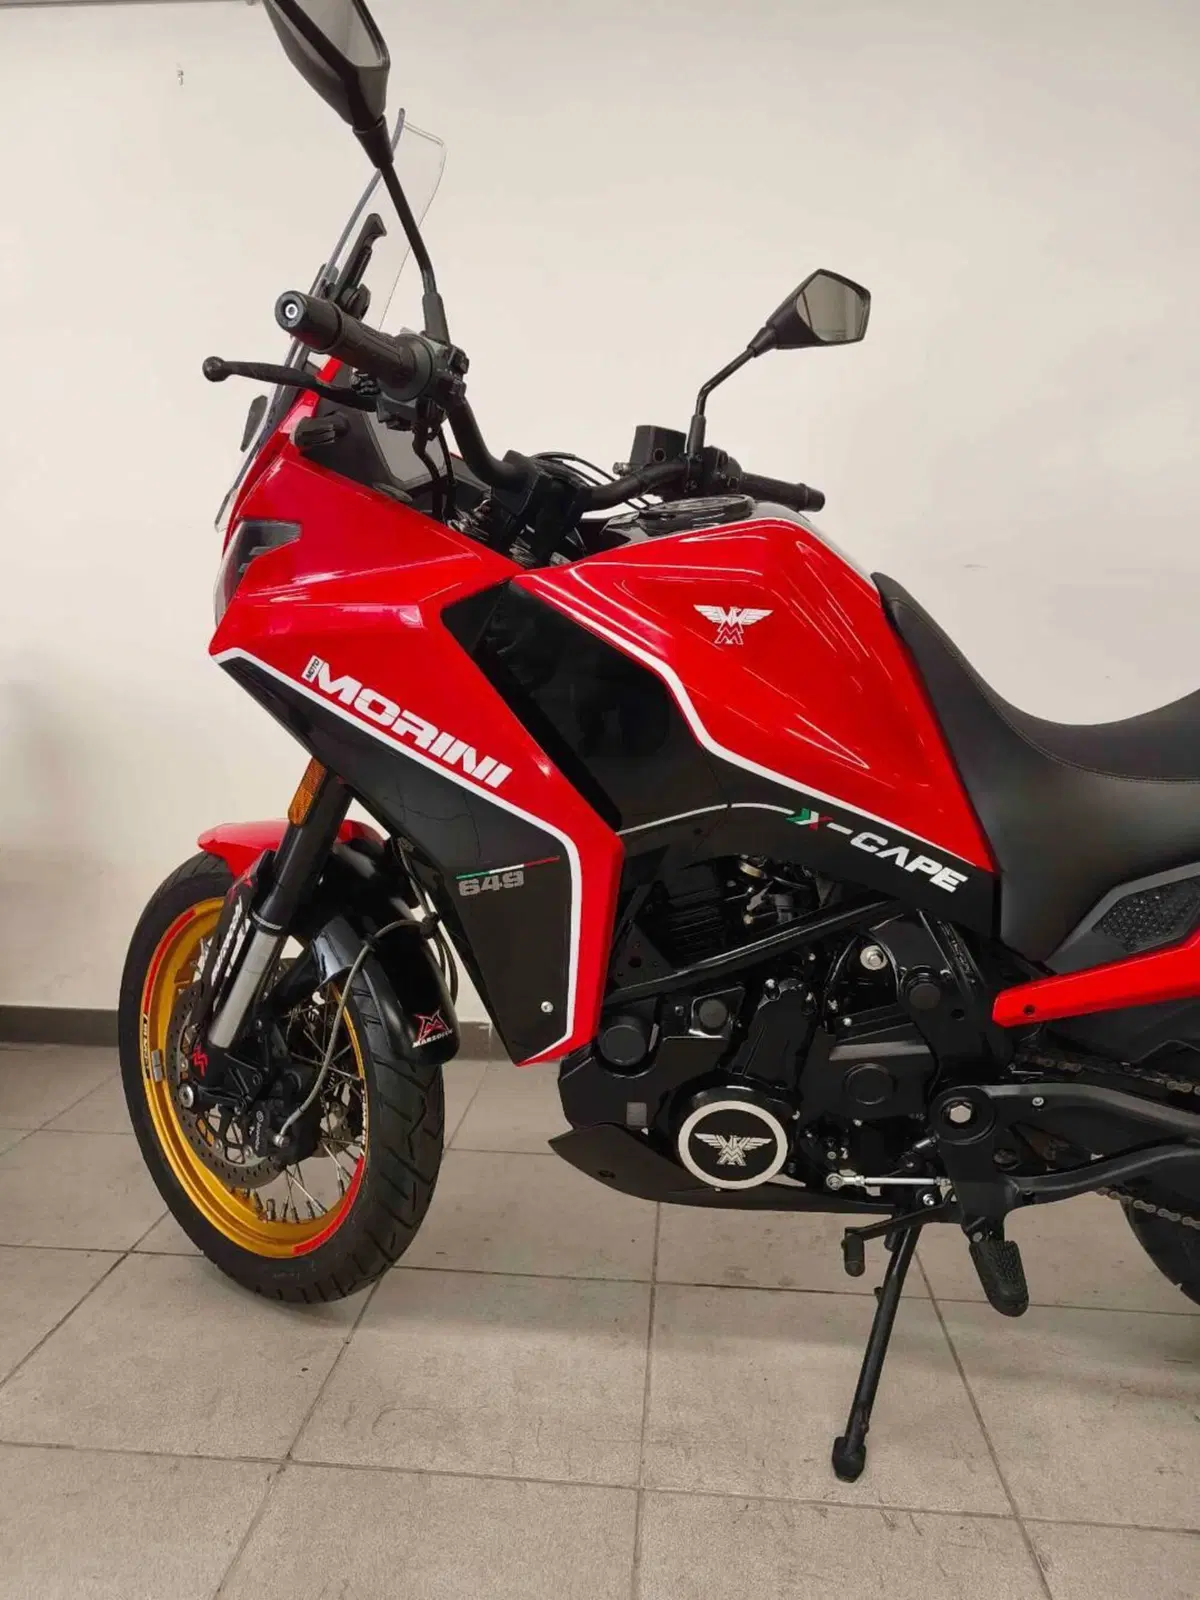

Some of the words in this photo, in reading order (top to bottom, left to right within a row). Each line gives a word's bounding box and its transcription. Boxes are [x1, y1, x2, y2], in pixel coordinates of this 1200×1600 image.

[301, 655, 513, 789] MORINI
[458, 869, 525, 897] 649
[785, 807, 969, 893] X-CAPE
